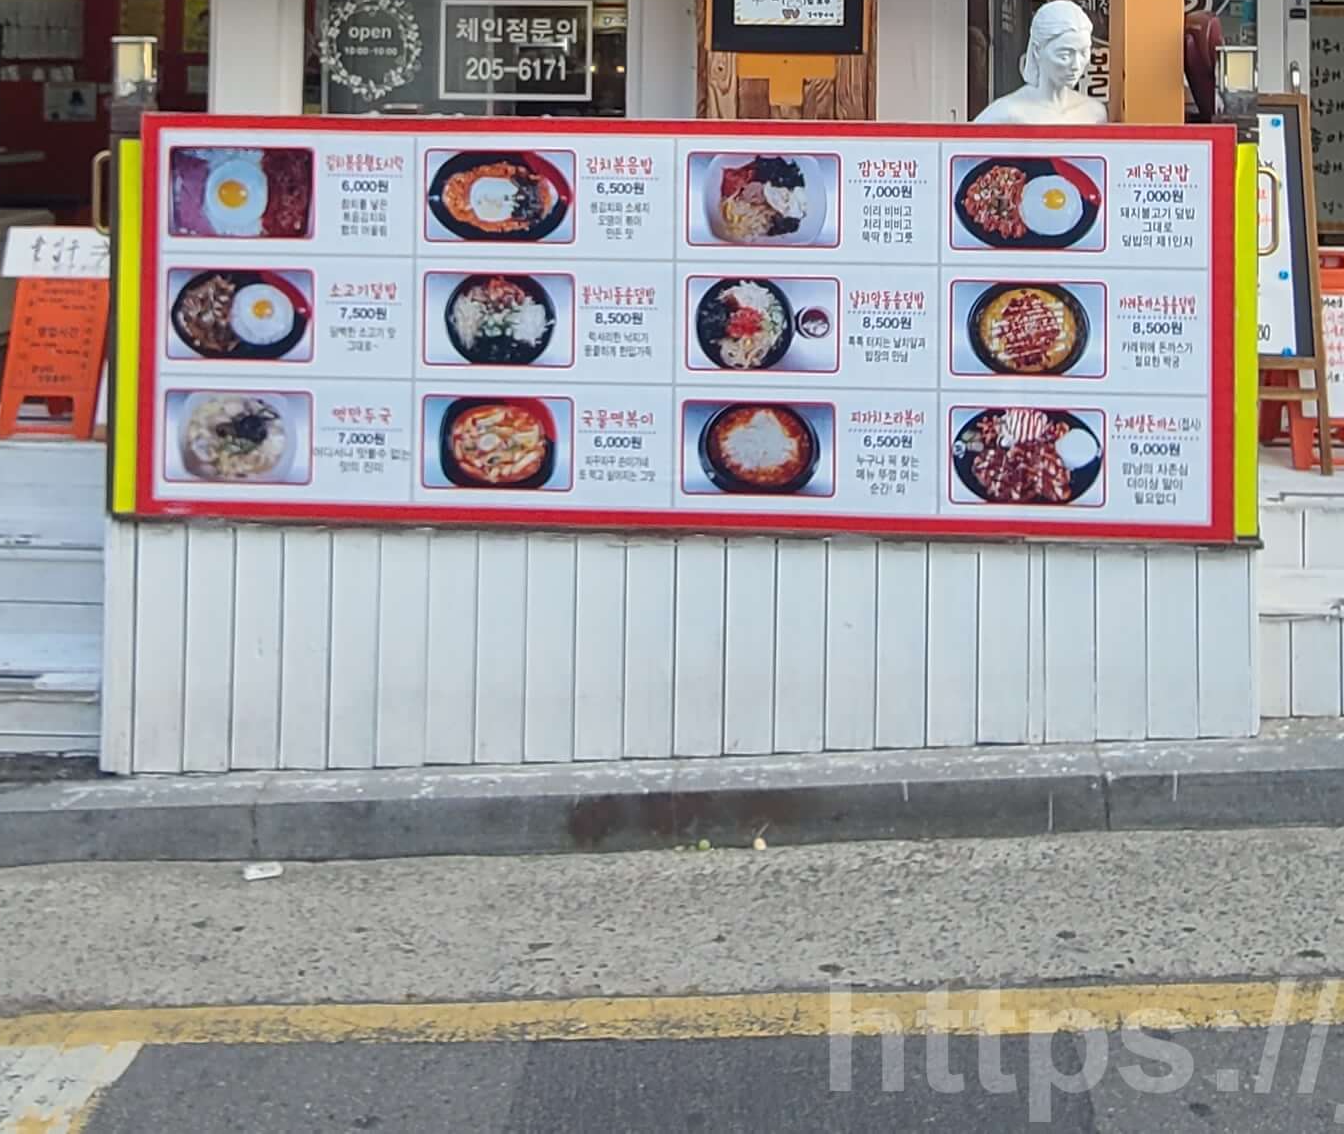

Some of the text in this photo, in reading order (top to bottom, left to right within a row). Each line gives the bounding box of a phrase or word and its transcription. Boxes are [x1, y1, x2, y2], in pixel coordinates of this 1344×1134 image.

[348, 26, 392, 43] open
[456, 18, 579, 44] 체인점문의
[465, 57, 568, 82] 205-6171
[585, 155, 653, 175] 김치볶음밥
[857, 159, 919, 179] 깜냥덮밥
[1126, 163, 1191, 183] 제육덮밥
[341, 179, 389, 193] 6,000원
[595, 181, 645, 196] 6,500원
[863, 185, 913, 199] 7,000원
[1133, 189, 1184, 204] 7,000원
[862, 204, 913, 217] 이리 비비고
[884, 218, 913, 231] 비비고
[328, 281, 398, 301] 소고기덮밥
[849, 290, 925, 310] 날치알돌솥덮밥
[339, 306, 388, 321] 7,500원
[595, 311, 644, 326] 8,500원
[862, 316, 913, 330] 8,500원
[1132, 321, 1183, 336] 8,500원
[332, 406, 392, 424] 떡만두국
[581, 409, 654, 429] 국물떡볶이
[851, 408, 925, 427] 피자치즈라볶이
[337, 432, 386, 446] 7,000원
[593, 435, 643, 450] 6,000원
[863, 435, 913, 449] 6,500원
[1129, 442, 1181, 457] 9,000원
